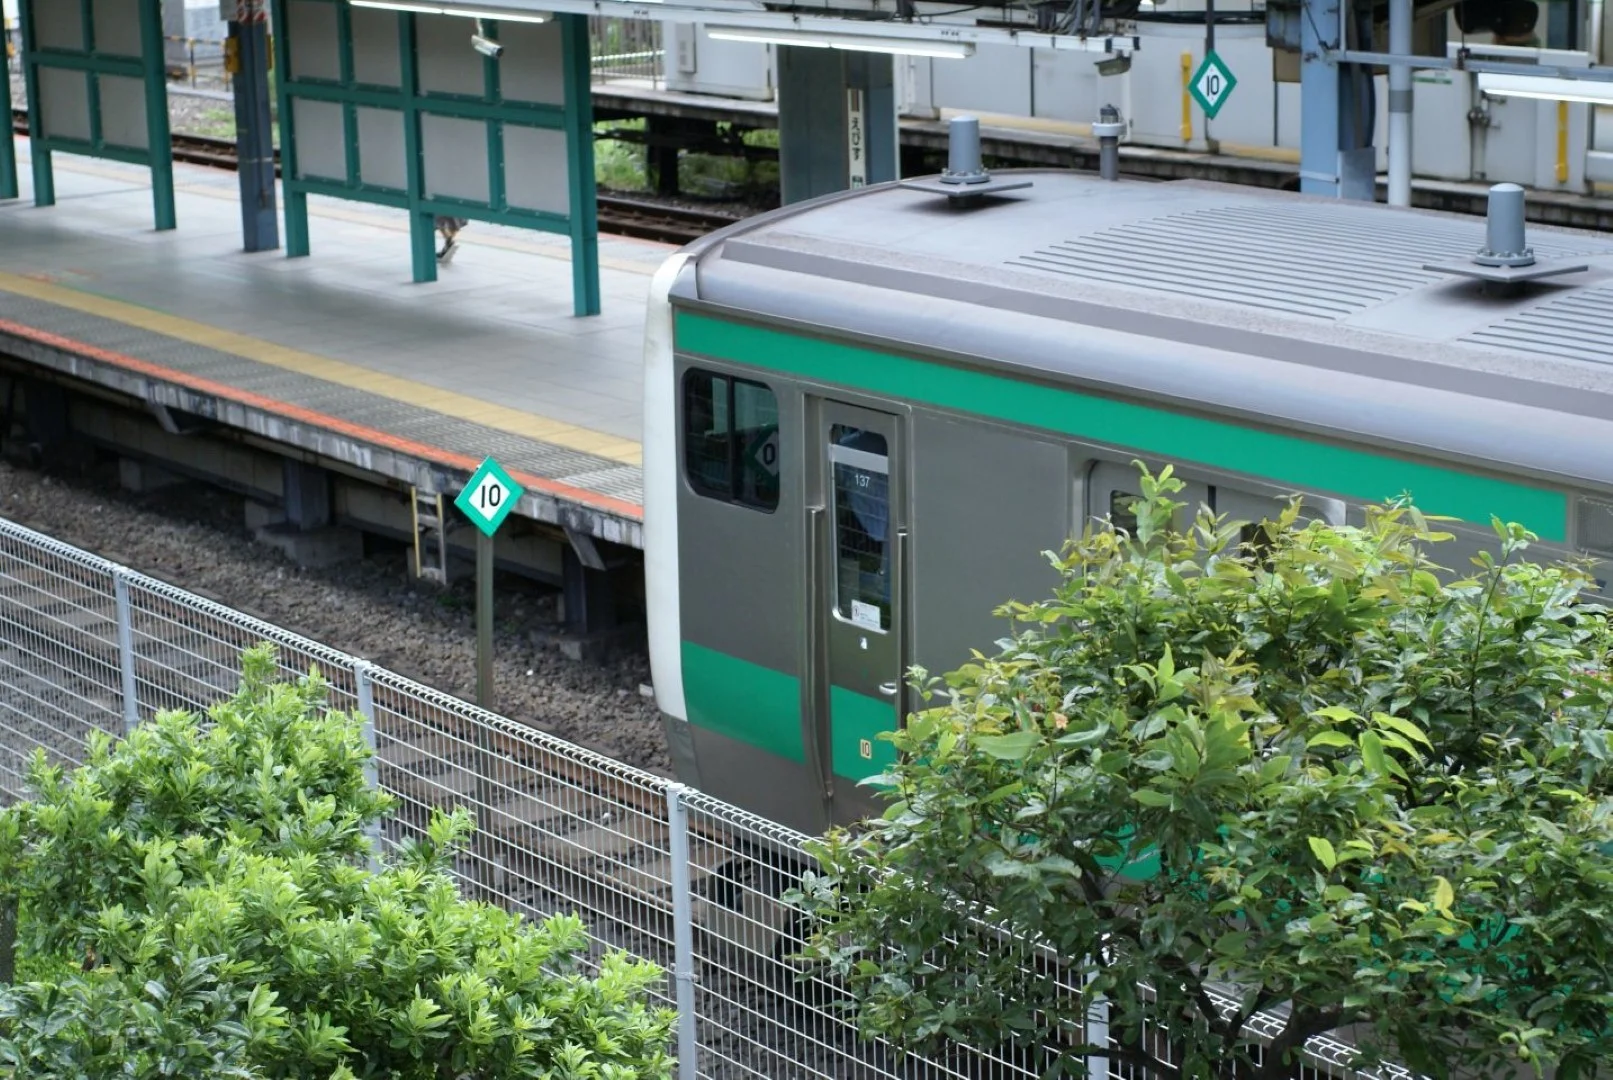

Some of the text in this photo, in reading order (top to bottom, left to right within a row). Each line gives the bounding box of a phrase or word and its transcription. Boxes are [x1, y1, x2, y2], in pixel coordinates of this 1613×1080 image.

[1207, 74, 1220, 97] 10
[851, 117, 861, 161] えびす
[854, 473, 871, 488] 137
[481, 484, 501, 508] 10
